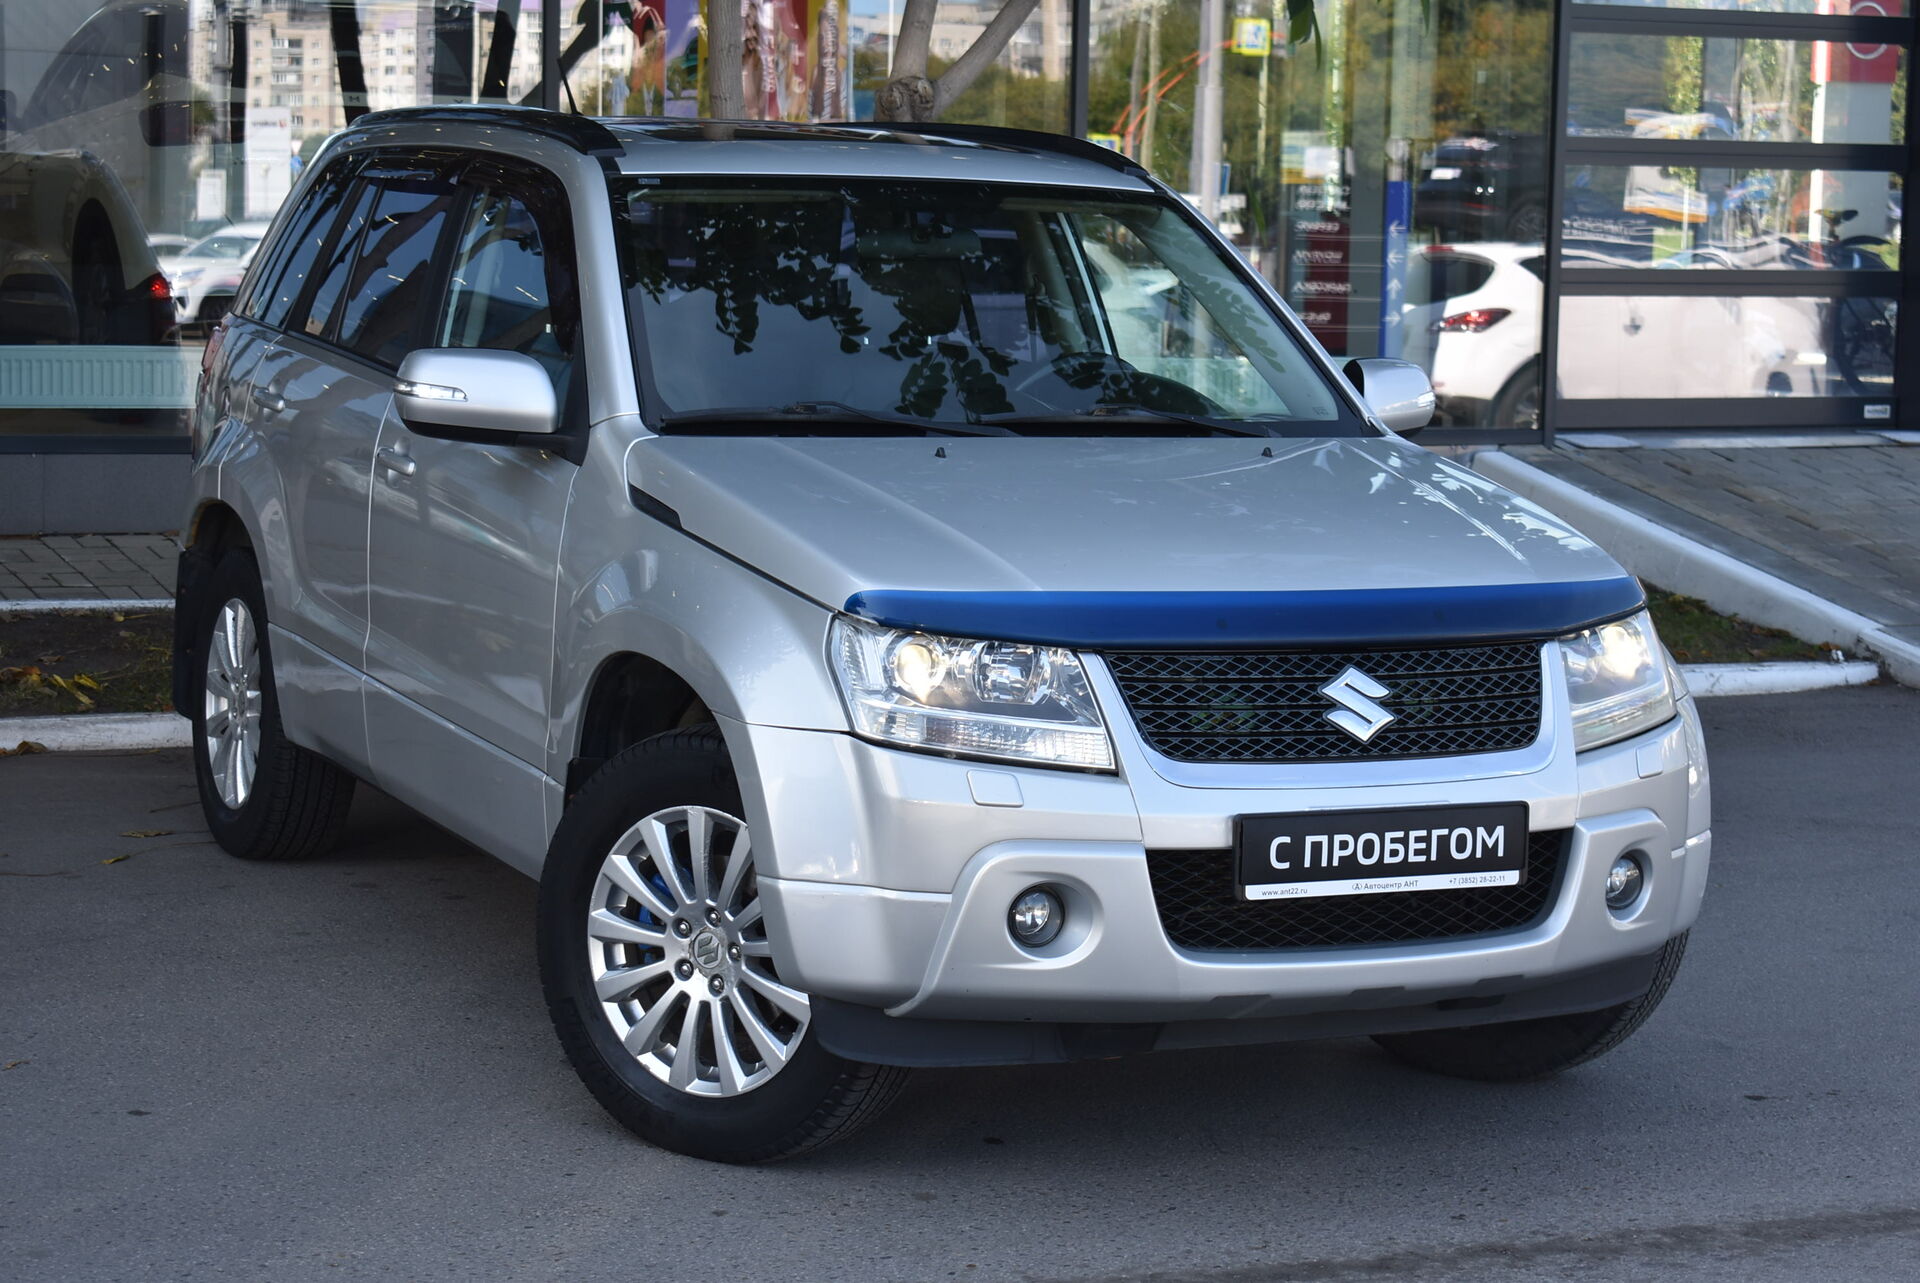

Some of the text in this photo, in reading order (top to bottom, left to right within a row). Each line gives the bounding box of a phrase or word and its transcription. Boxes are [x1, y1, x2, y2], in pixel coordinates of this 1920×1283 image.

[1269, 825, 1505, 870] С ПРОБЕГОМ
[1261, 887, 1308, 896] www.ant22.ru
[1364, 882, 1402, 890] Автоцентр
[1403, 880, 1419, 888] АНТ
[1458, 877, 1479, 885] (3852)
